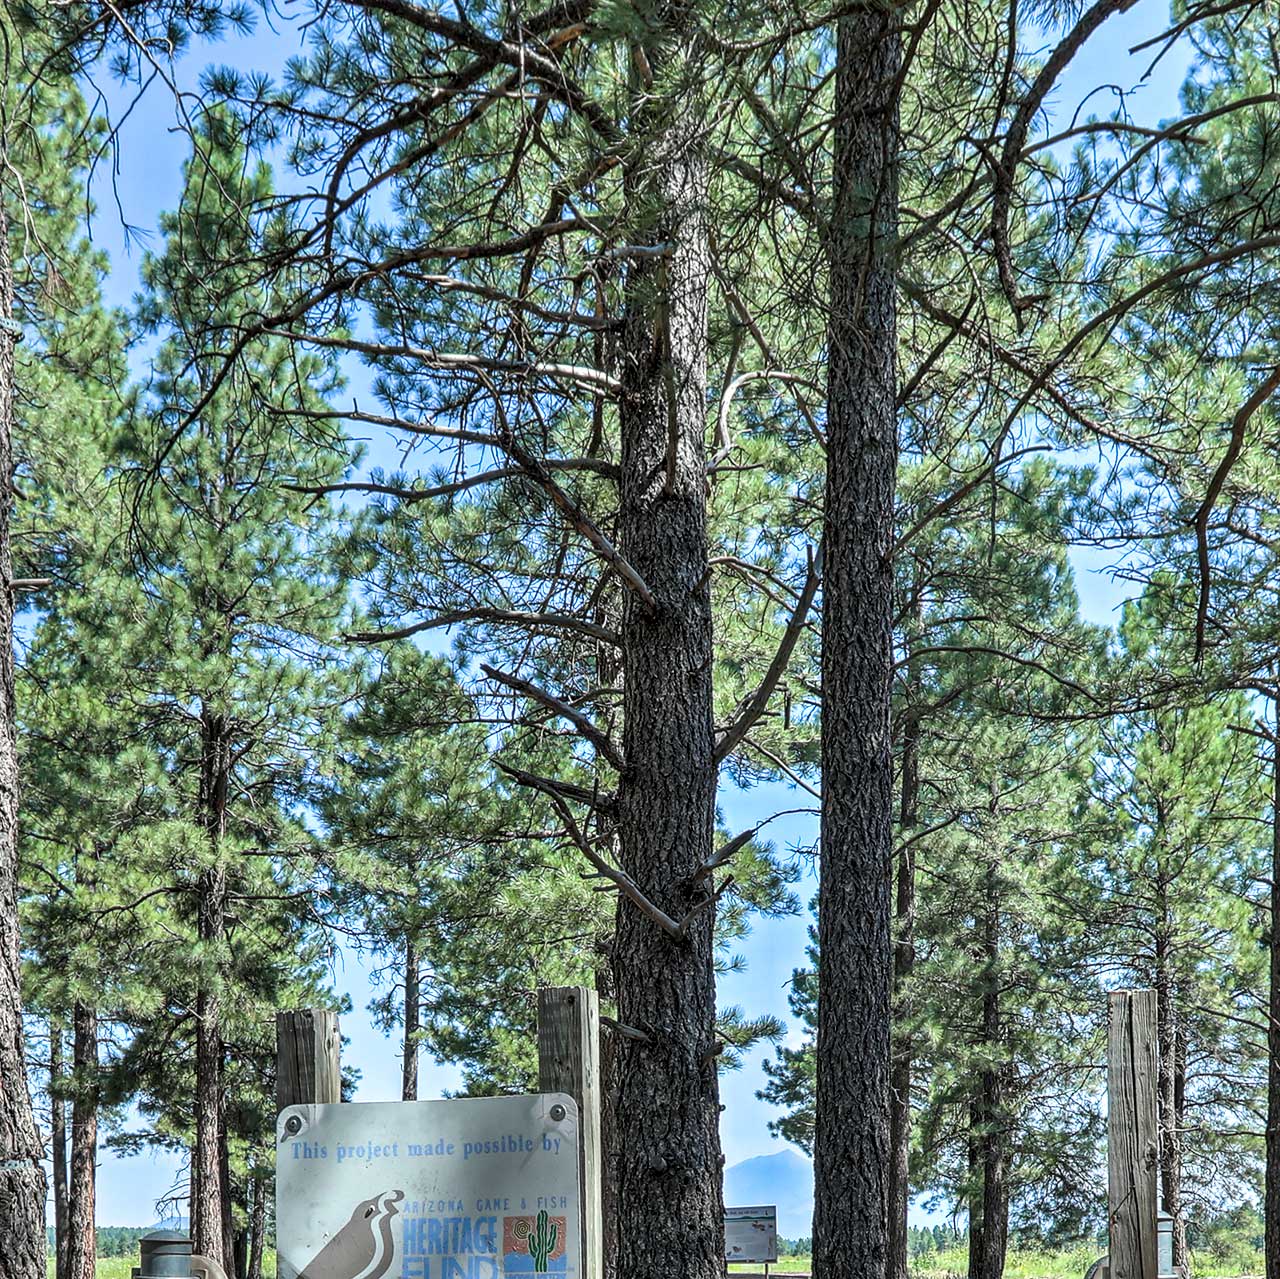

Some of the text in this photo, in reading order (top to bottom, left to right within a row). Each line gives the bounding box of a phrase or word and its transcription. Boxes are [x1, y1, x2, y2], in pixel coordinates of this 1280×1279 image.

[291, 1133, 560, 1163] This project made possible by
[404, 1200, 464, 1213] ARIZONA
[477, 1198, 510, 1212] GAME
[537, 1197, 568, 1209] FISH
[402, 1215, 498, 1255] HERITAGE
